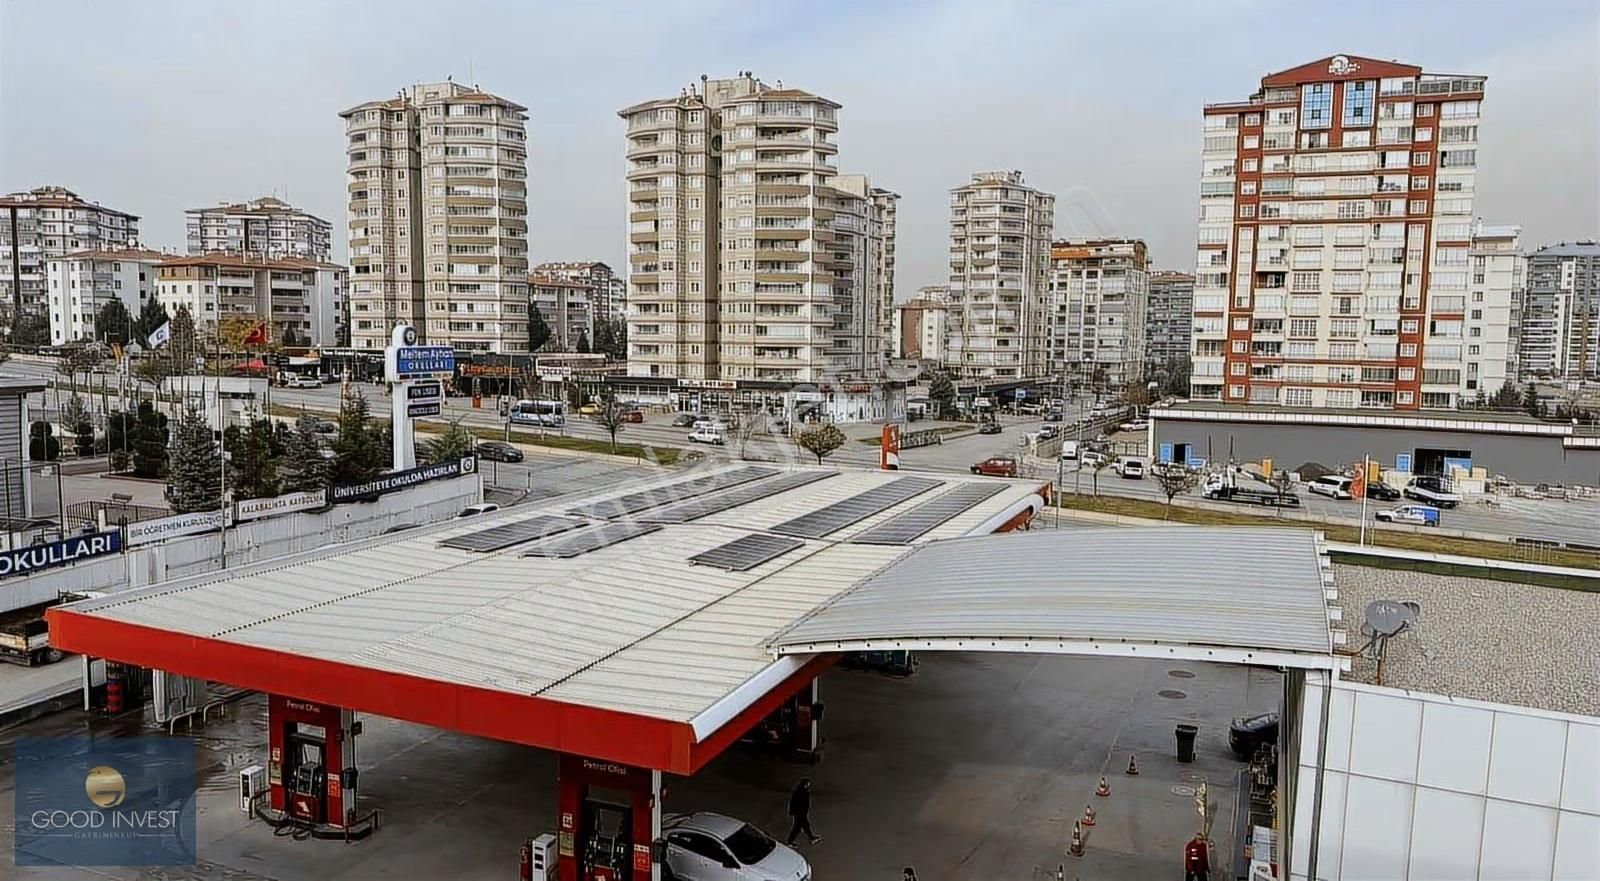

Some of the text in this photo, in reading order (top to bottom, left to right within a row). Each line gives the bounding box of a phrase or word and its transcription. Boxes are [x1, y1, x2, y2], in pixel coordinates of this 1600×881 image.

[400, 349, 430, 360] Meltem
[334, 464, 458, 499] ÜNİVERSİTEYE OKULDA HAZIRLAN
[0, 535, 112, 575] OKULLARI
